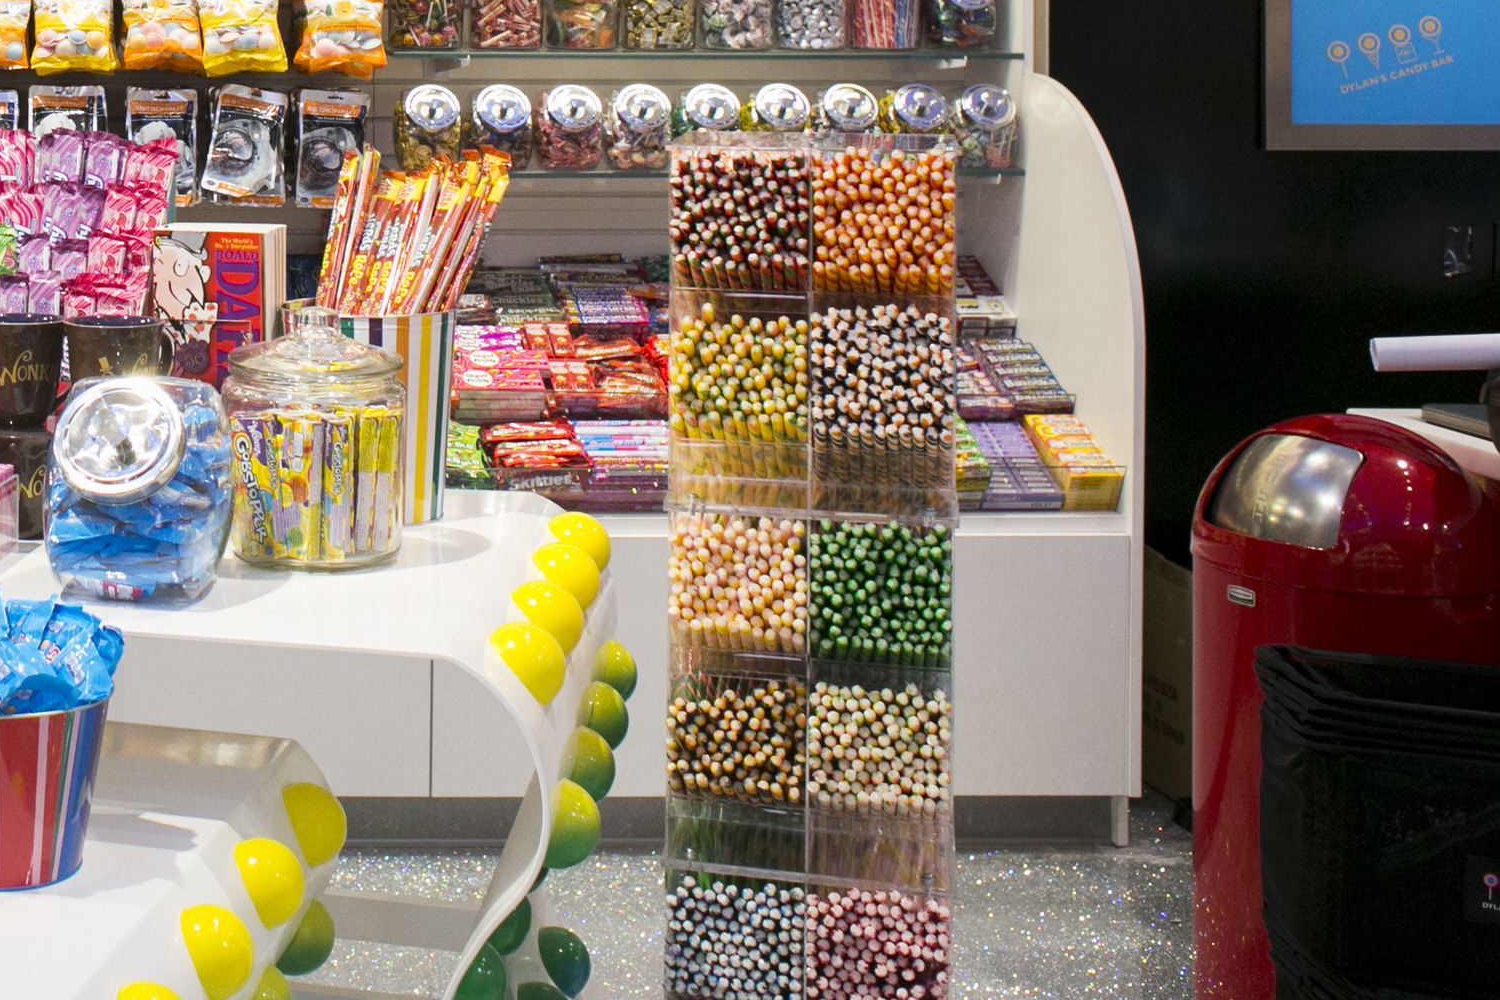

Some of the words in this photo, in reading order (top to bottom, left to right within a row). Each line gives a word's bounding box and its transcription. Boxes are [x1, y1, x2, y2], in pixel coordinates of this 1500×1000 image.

[1339, 74, 1388, 94] DYLAN'S
[1389, 62, 1429, 81] CANDY
[1430, 55, 1455, 69] BAR
[215, 249, 259, 261] ROALD
